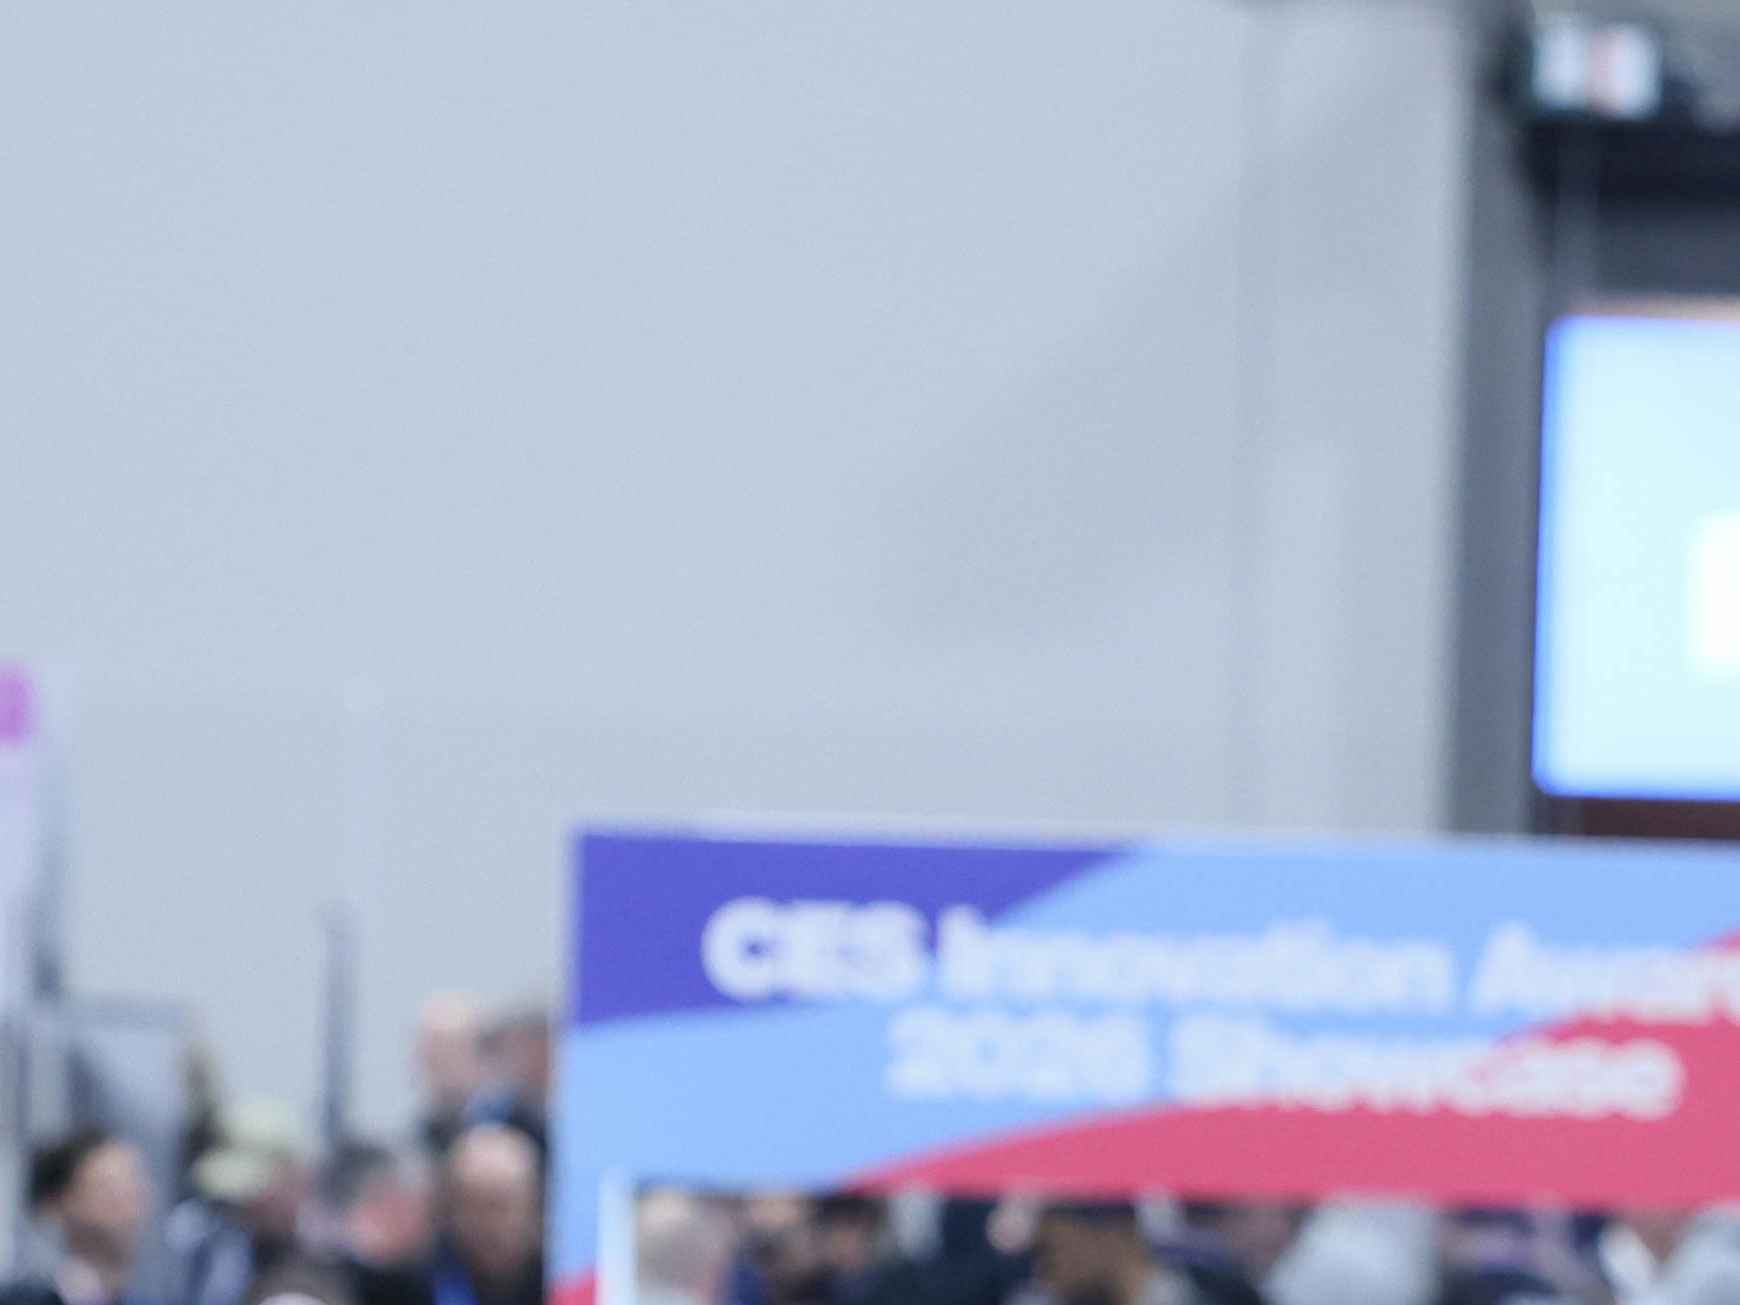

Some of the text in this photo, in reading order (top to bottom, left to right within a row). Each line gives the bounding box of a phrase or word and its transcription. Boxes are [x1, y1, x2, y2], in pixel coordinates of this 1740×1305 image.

[701, 897, 930, 1003] CES
[936, 902, 1457, 1014] Innovation
[1171, 1012, 1685, 1118] Showcase
